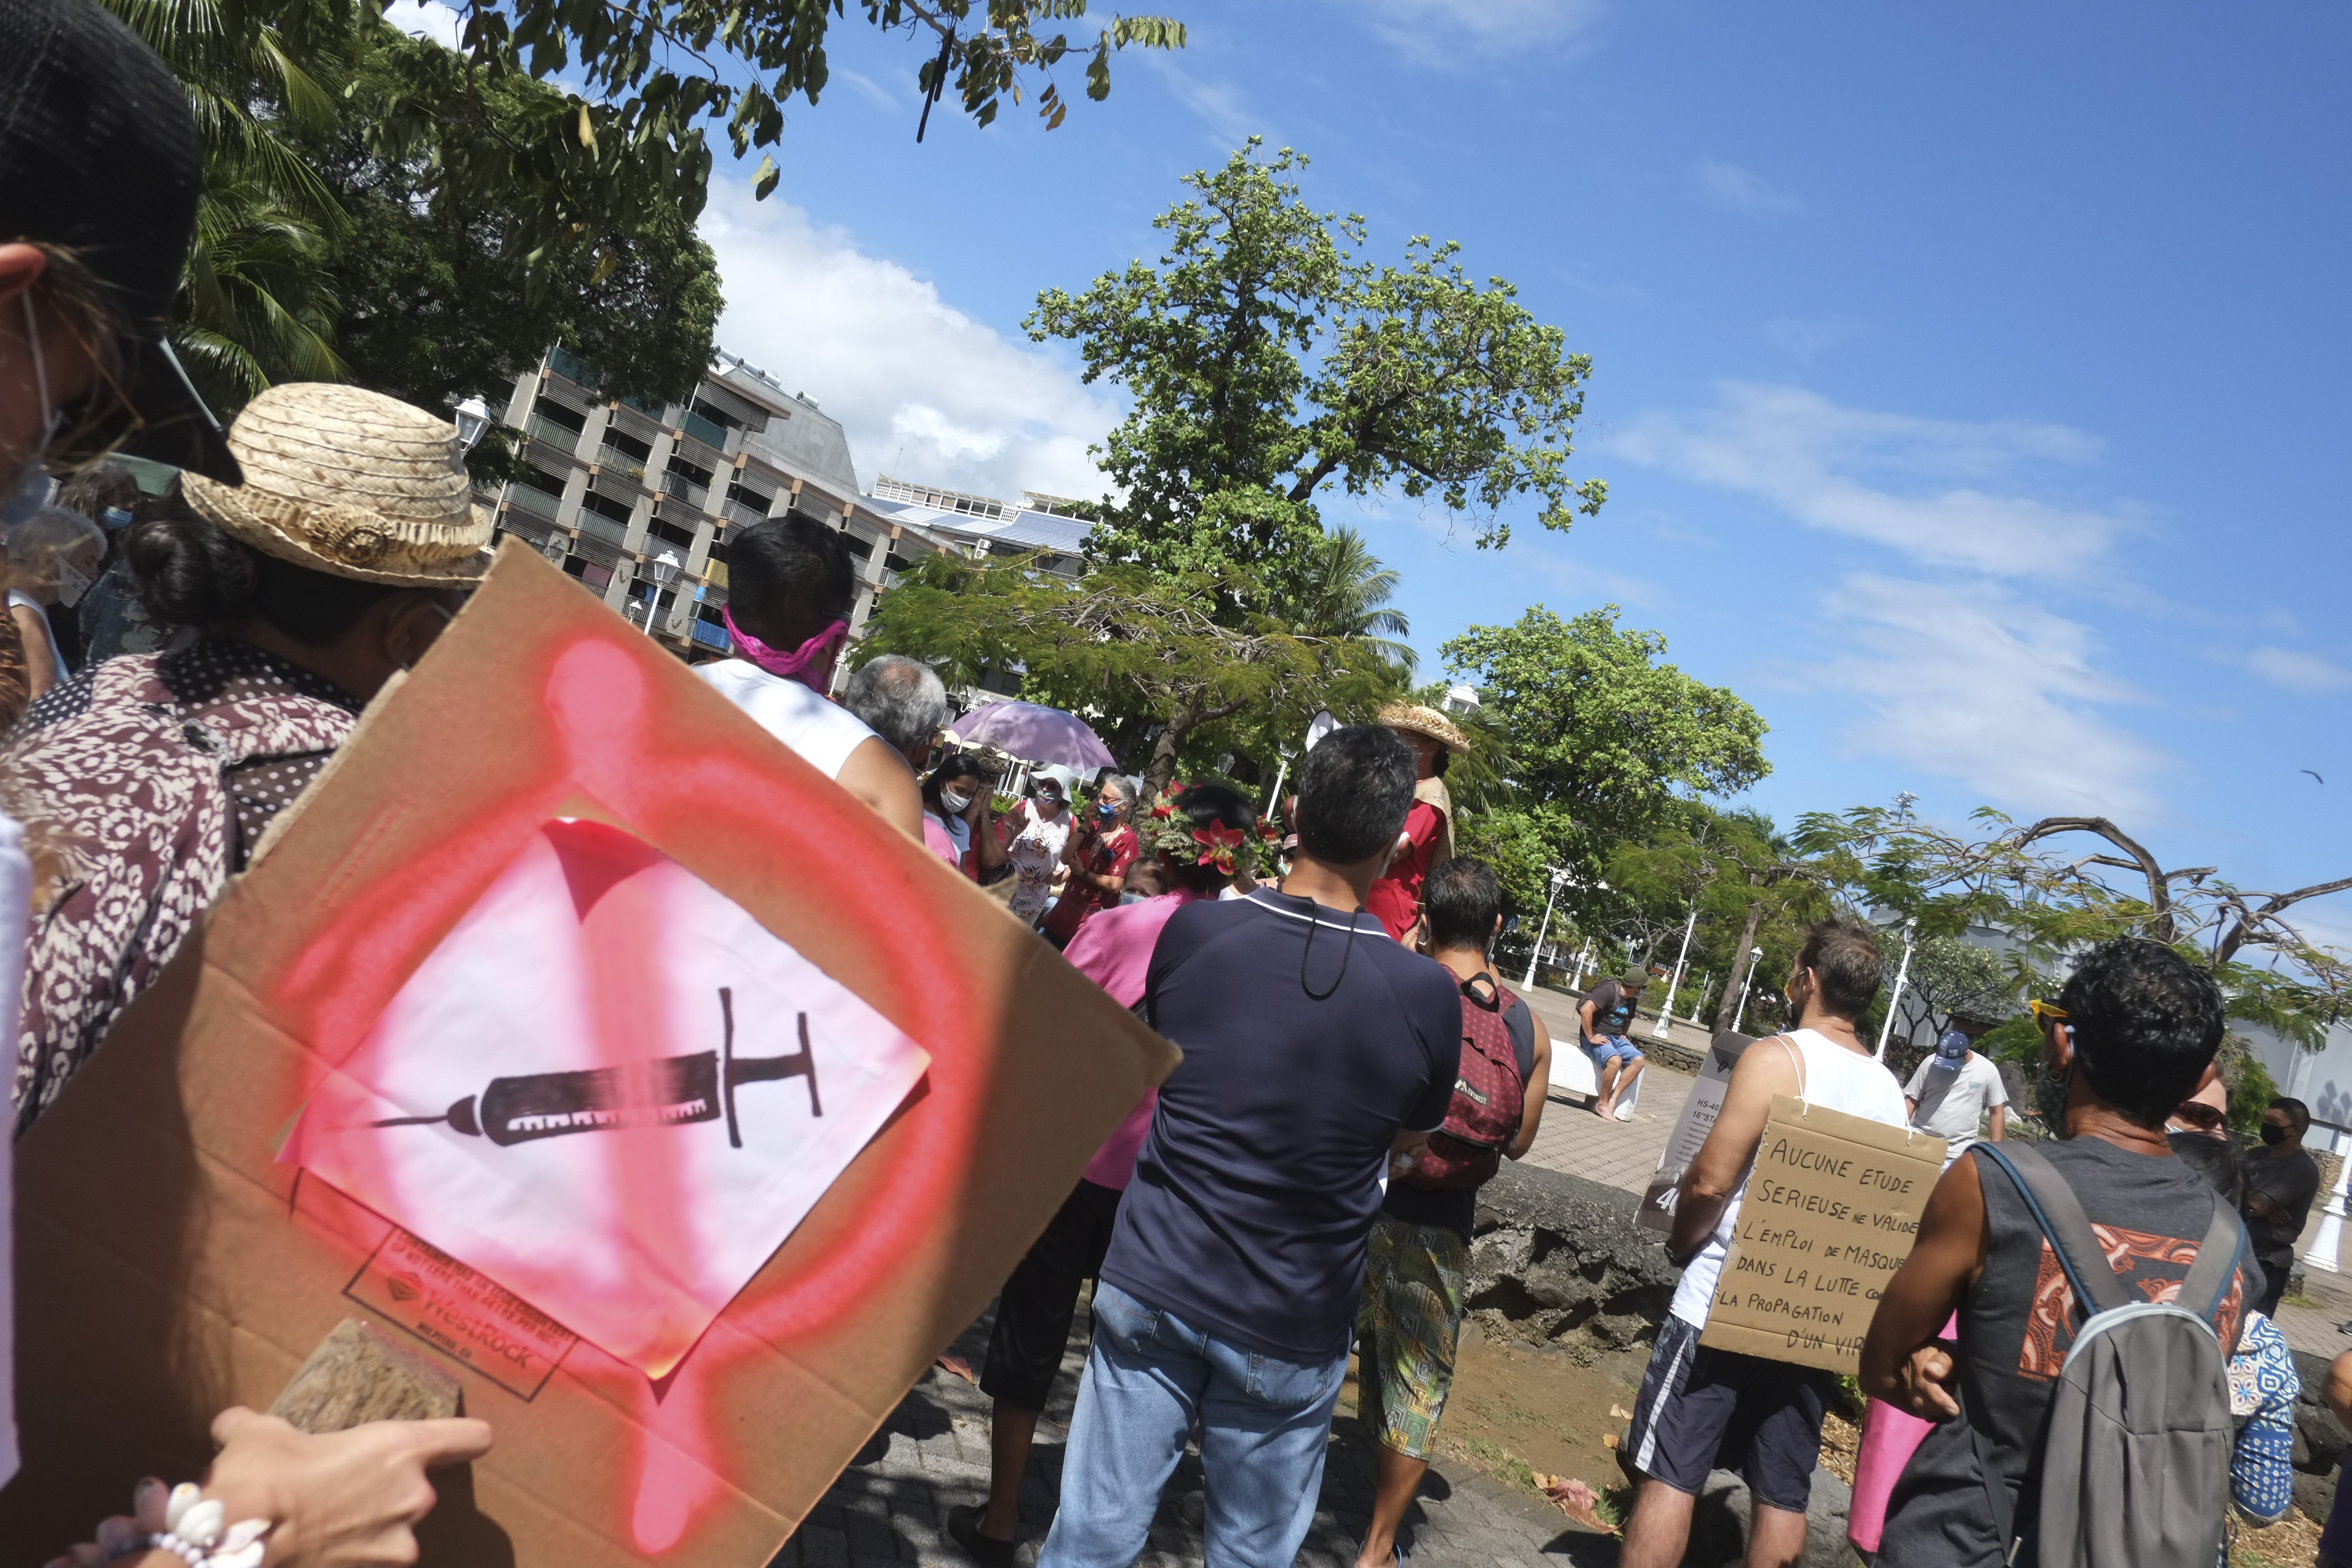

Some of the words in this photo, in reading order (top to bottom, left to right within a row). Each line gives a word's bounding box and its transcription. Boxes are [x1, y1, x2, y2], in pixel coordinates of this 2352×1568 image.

[1468, 1087, 1487, 1104] EVEREST
[1770, 1139, 1853, 1178] AUCUNE
[1859, 1169, 1914, 1193] ETUDE
[1757, 1179, 1851, 1220] SERIEUSE
[1852, 1212, 1867, 1224] NE
[1873, 1213, 1920, 1234] VALIDE
[1742, 1220, 1814, 1253] L'EMPLOI
[1824, 1246, 1840, 1258] DE
[1736, 1256, 1778, 1277] DANS
[1784, 1267, 1808, 1288] LA
[1814, 1275, 1860, 1296] LUTTE
[1719, 1291, 1737, 1307] LA
[1747, 1294, 1844, 1326] PROPAGATION
[424, 1290, 533, 1369] WestRock
[1787, 1328, 1826, 1350] D'UN
